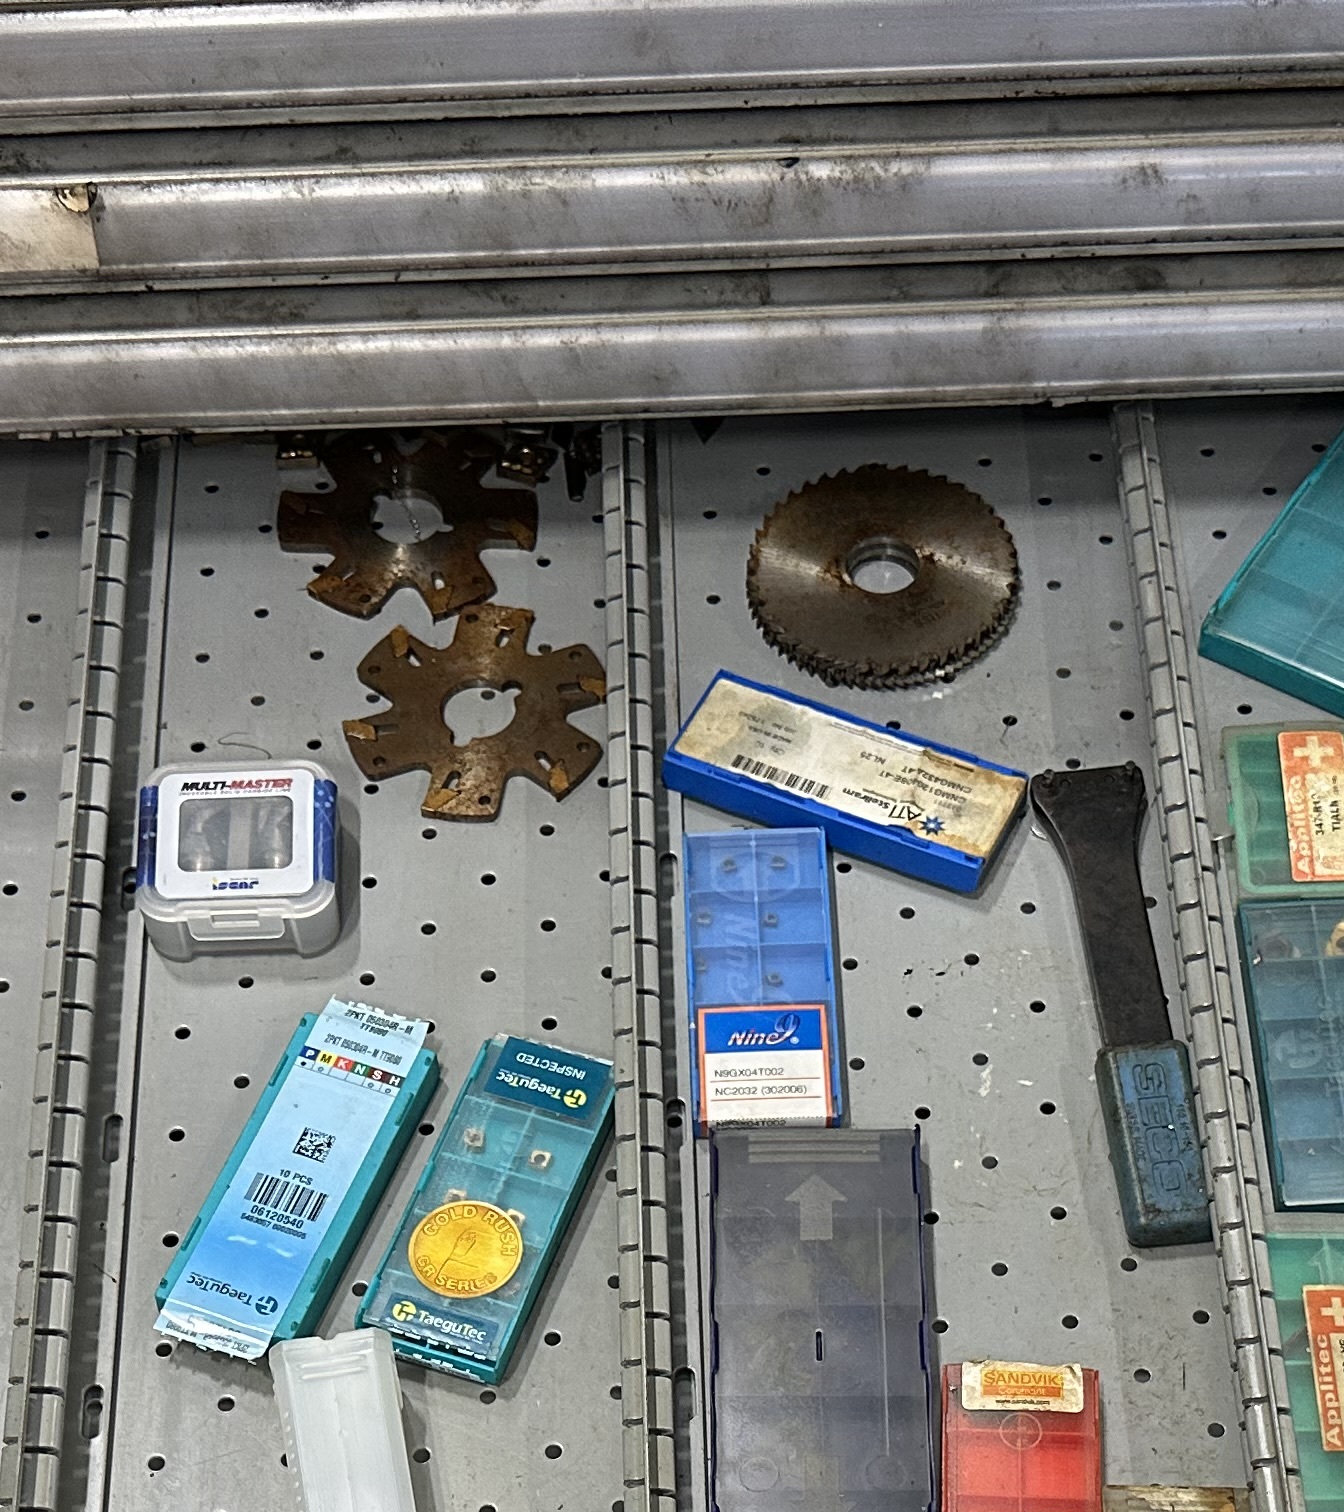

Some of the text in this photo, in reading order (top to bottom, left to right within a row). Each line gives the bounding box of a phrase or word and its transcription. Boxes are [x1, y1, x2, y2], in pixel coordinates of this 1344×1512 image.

[304, 1048, 401, 1086] P M K N S H
[516, 1052, 586, 1080] INSPECTED
[496, 1071, 561, 1099] TaeguTec
[279, 1168, 314, 1186] 10 PCS
[249, 1204, 304, 1229] 06120540
[421, 1204, 519, 1258] GOLD RUSH
[186, 1273, 254, 1308] TaeguTec
[418, 1309, 487, 1341] TaeguTec
[983, 1371, 1060, 1386] SANDVIK
[1313, 1333, 1344, 1447] Applitec
